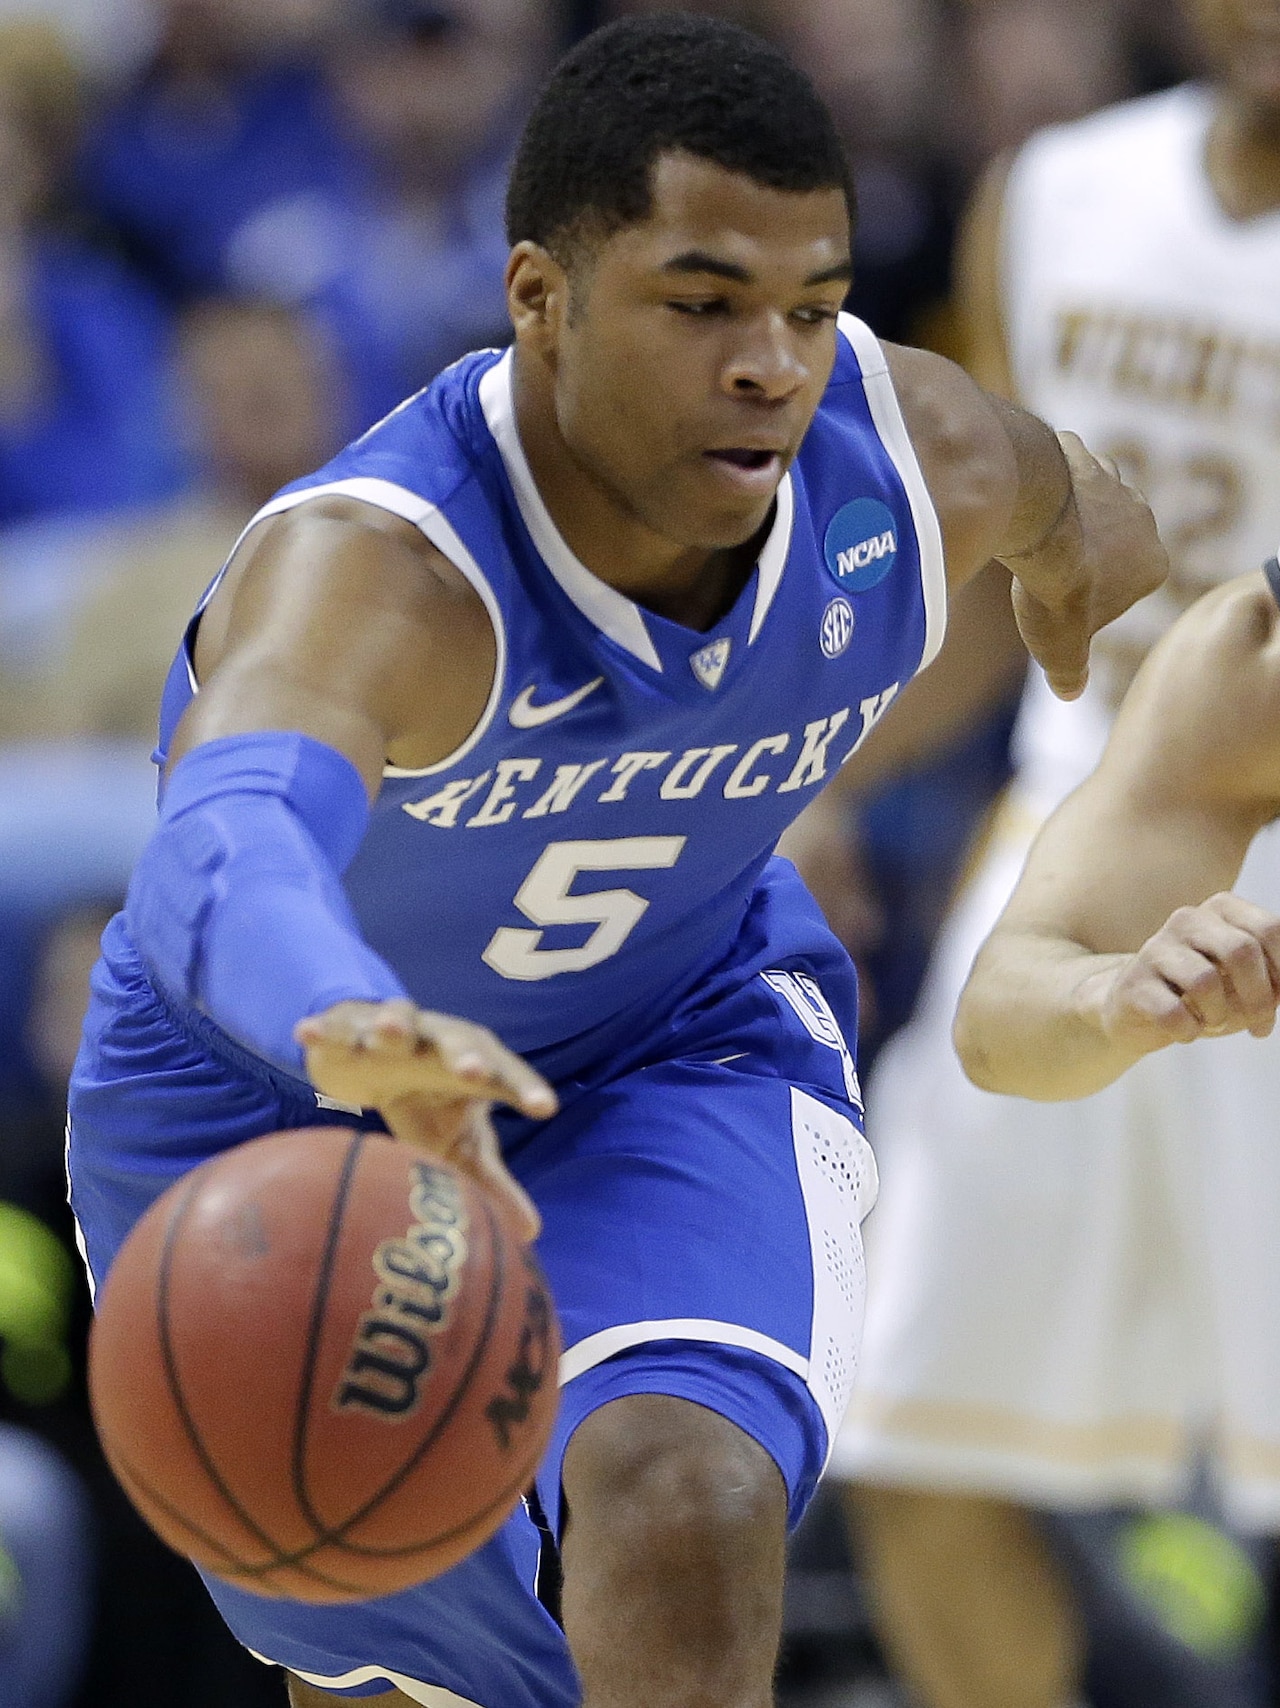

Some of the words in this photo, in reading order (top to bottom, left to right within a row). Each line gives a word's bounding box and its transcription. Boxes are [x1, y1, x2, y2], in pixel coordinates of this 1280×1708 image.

[836, 529, 897, 577] NCAA
[822, 603, 852, 655] SEC
[401, 681, 900, 828] KENTUCKY
[480, 834, 687, 981] 5
[330, 1160, 472, 1423] Wilson
